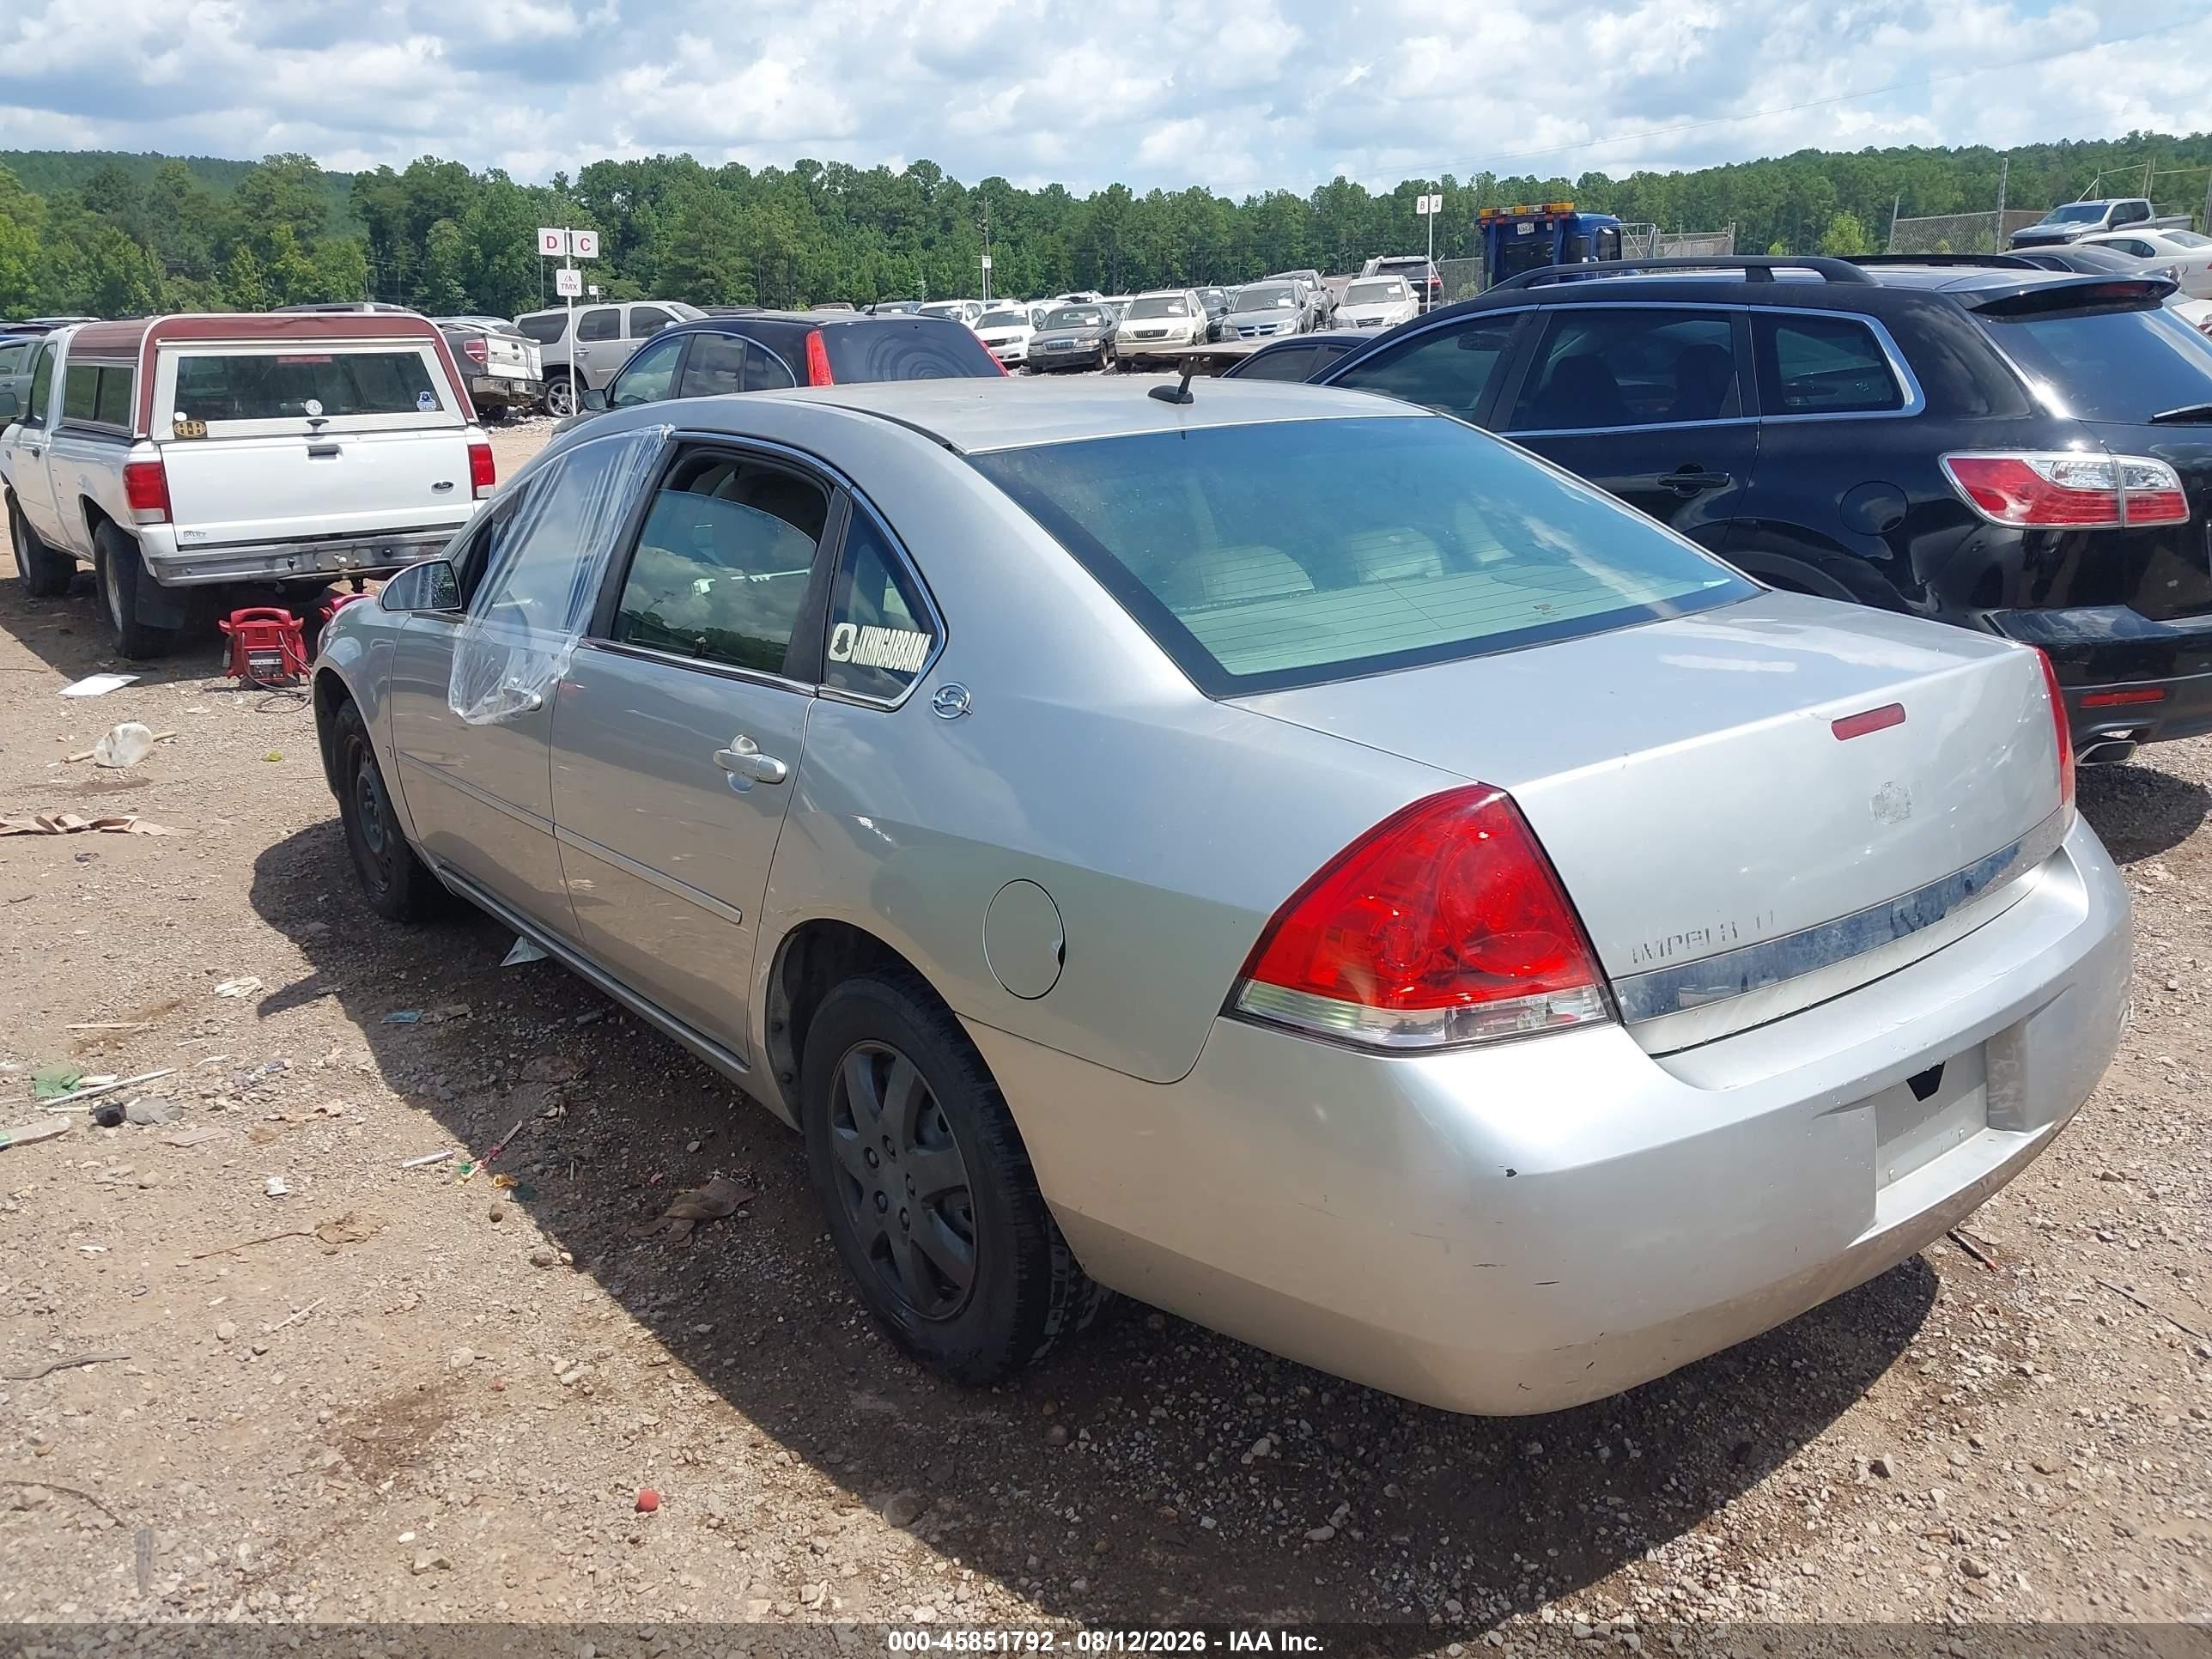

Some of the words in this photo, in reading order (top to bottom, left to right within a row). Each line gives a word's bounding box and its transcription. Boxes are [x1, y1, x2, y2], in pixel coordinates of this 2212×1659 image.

[546, 235, 558, 249] D
[580, 237, 592, 252] C
[560, 283, 578, 291] TMX
[852, 625, 932, 673] JXHNGABBANA
